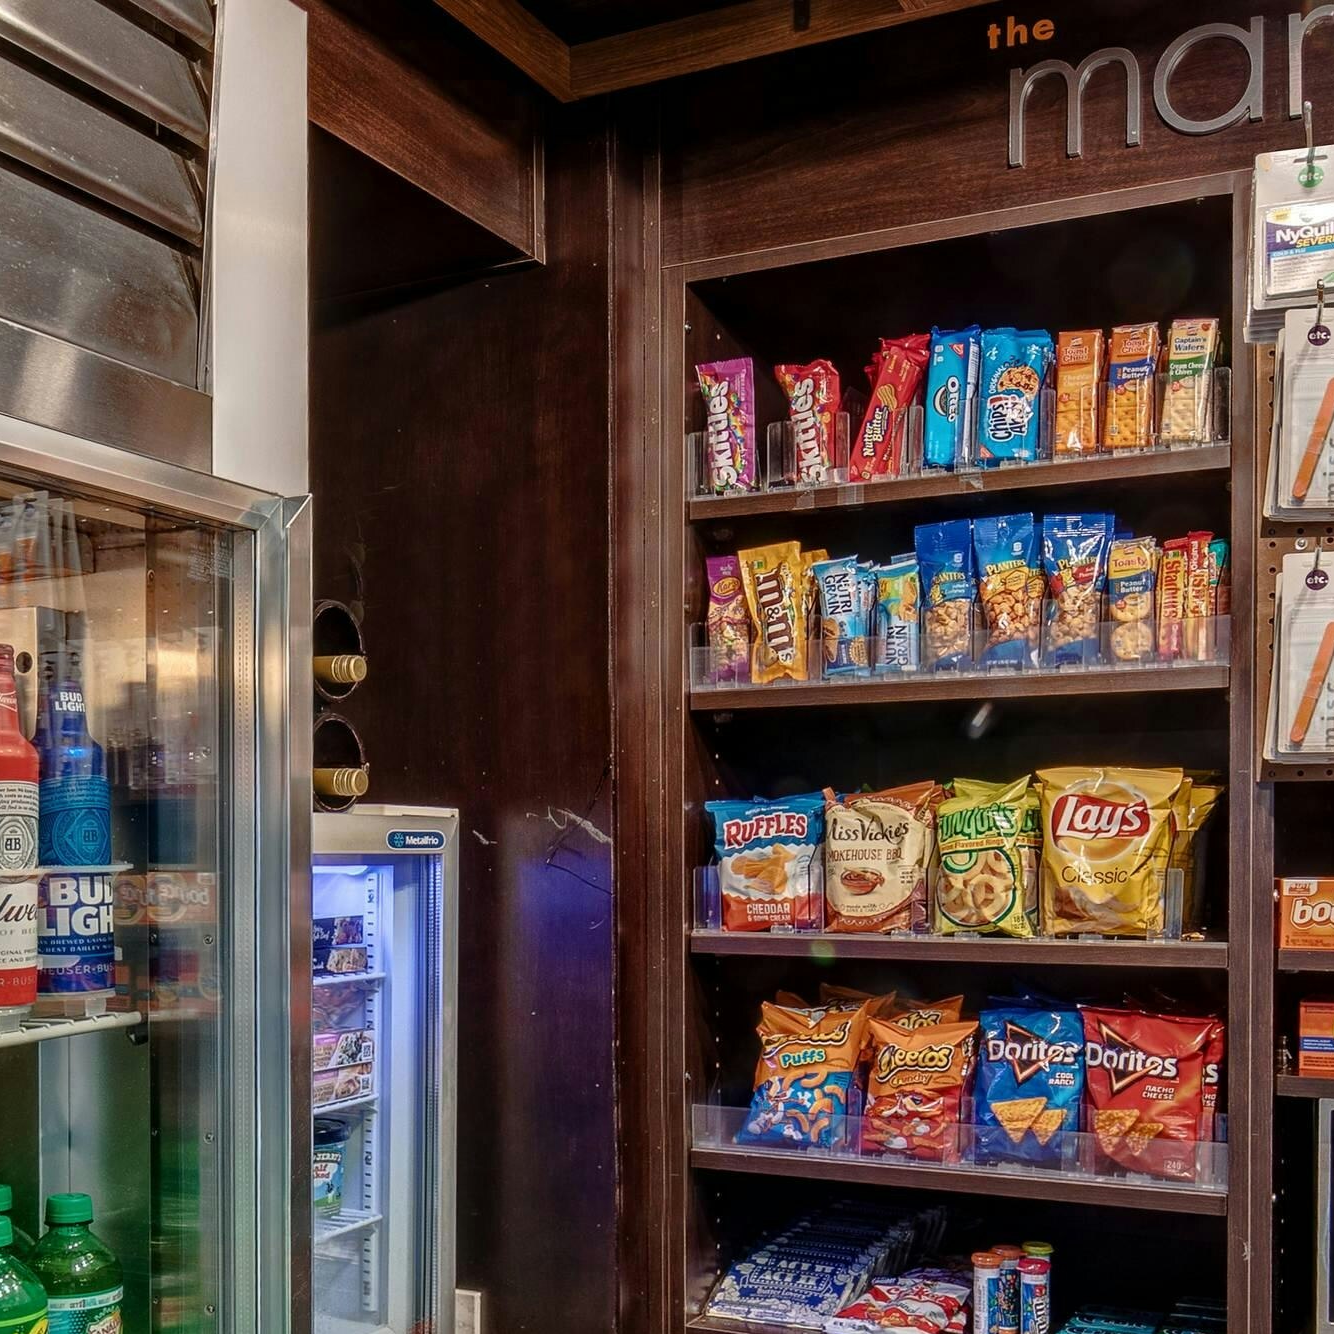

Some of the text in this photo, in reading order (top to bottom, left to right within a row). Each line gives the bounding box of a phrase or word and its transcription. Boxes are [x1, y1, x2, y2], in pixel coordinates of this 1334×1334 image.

[987, 17, 1056, 49] the
[1275, 222, 1334, 245] NyQuil
[1122, 366, 1149, 374] Peanut
[872, 406, 884, 443] Butter
[989, 402, 1013, 440] Chips
[862, 421, 875, 457] Nutter
[986, 559, 1026, 575] PLANTERS
[1112, 557, 1147, 567] Toasty
[835, 573, 853, 614] NUTRI
[1120, 580, 1144, 588] Peanut
[824, 575, 842, 617] GRAIN
[895, 625, 908, 666] GRAIN
[59, 691, 83, 702] BUD
[1056, 795, 1144, 839] Lay's
[405, 835, 439, 845] Metalfrio
[724, 813, 808, 849] RUFFLES
[857, 817, 909, 844] Vickie's
[963, 839, 984, 849] Flavored
[886, 848, 904, 861] BBQ
[1061, 865, 1129, 885] Classic
[49, 876, 113, 906] BUD
[746, 903, 790, 914] CHEDDAR
[780, 1049, 826, 1068] Puffs
[987, 1040, 1076, 1063] Doritos
[1085, 1041, 1178, 1078] Doritos
[889, 1073, 932, 1086] Crunchy
[1048, 1078, 1075, 1086] RANCH
[1054, 1071, 1074, 1079] COOL
[1142, 1091, 1174, 1100] CHEESE
[1145, 1085, 1174, 1094] NACHO
[759, 1271, 818, 1286] ACT II
